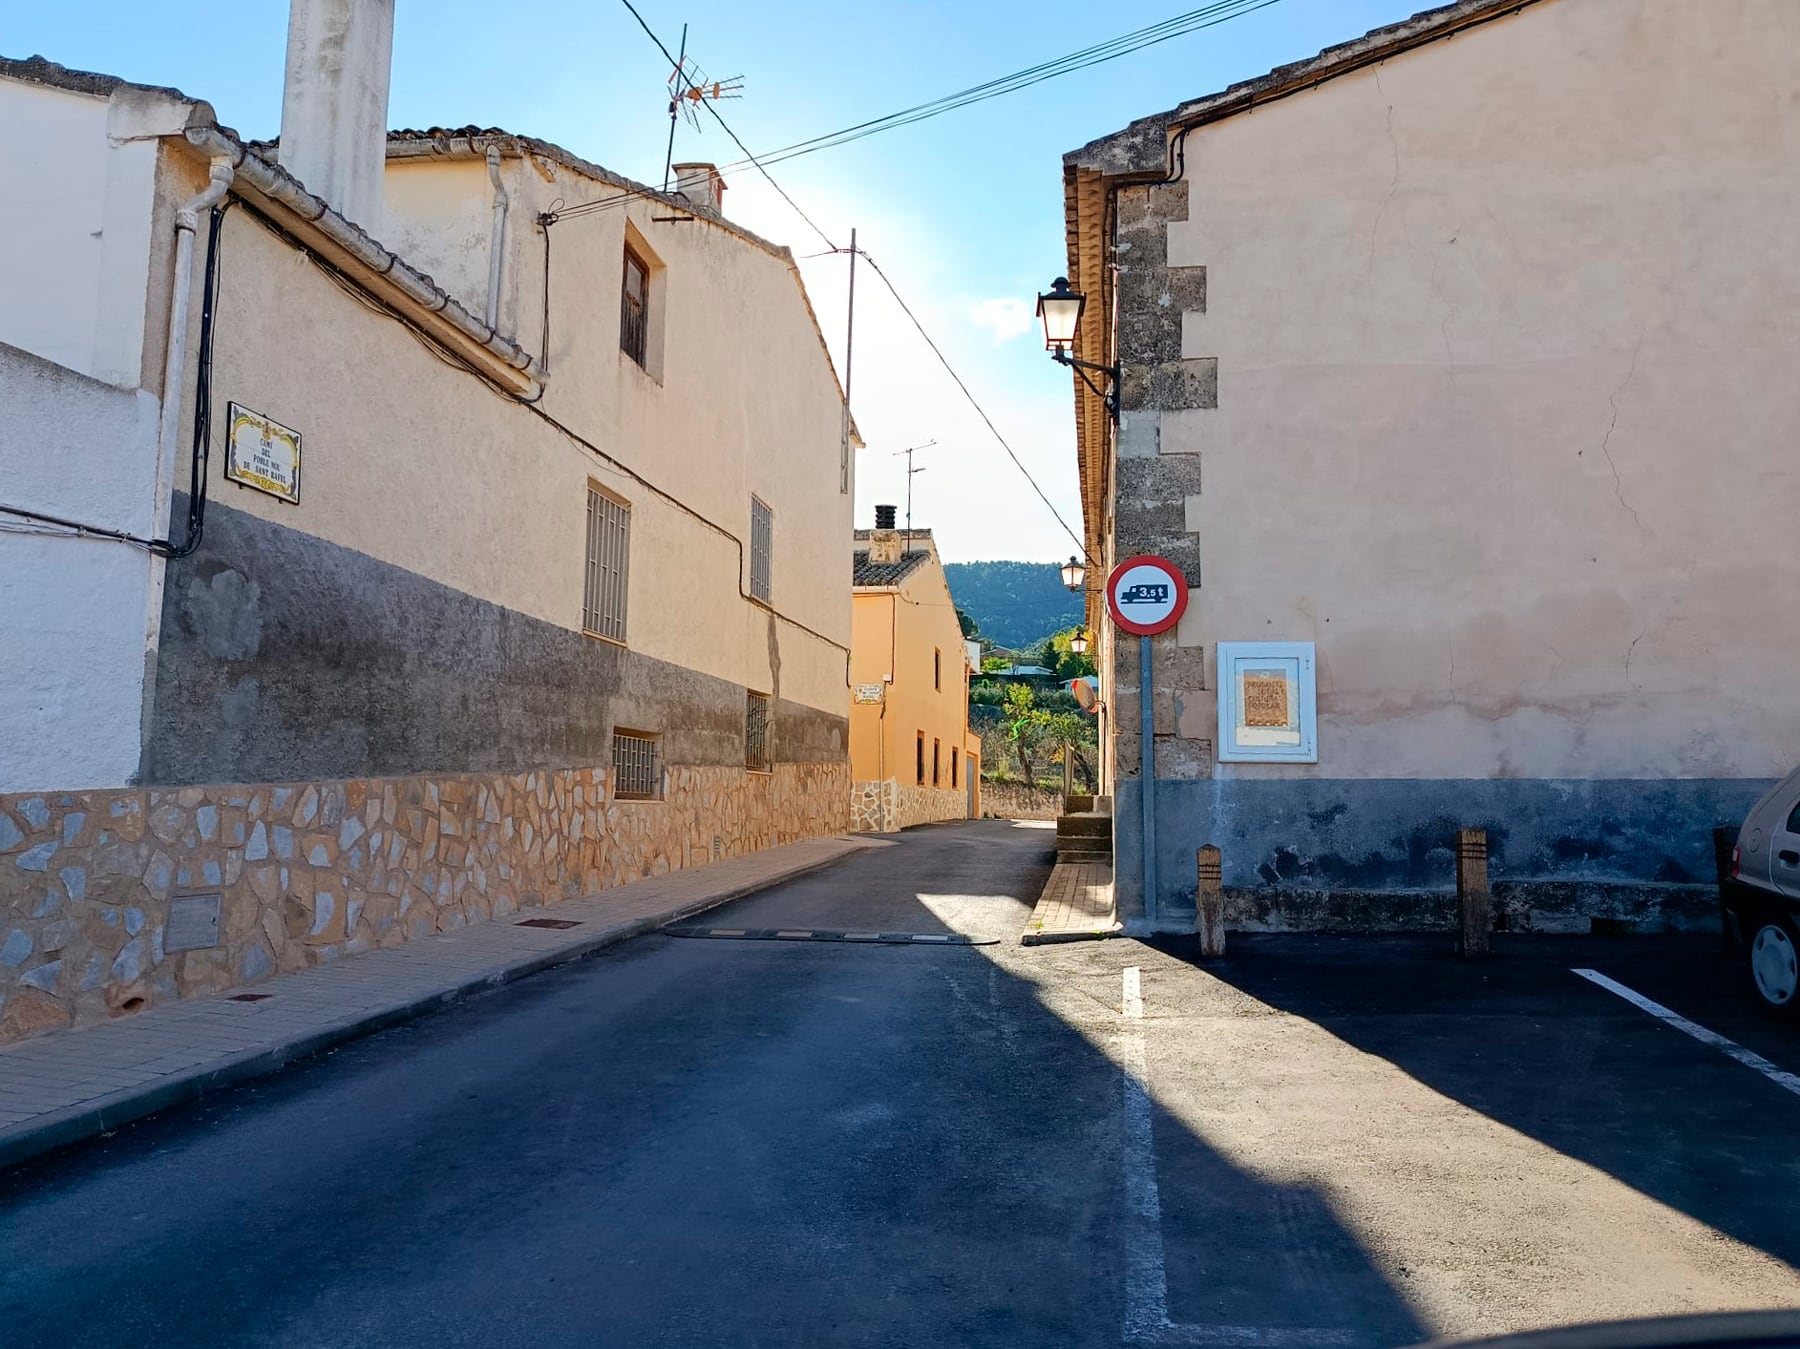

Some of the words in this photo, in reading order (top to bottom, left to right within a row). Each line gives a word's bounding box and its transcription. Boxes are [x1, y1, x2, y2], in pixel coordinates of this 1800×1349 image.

[262, 448, 270, 458] DEL
[244, 460, 250, 470] DE
[256, 466, 268, 477] SANT
[271, 471, 286, 484] RAFEL
